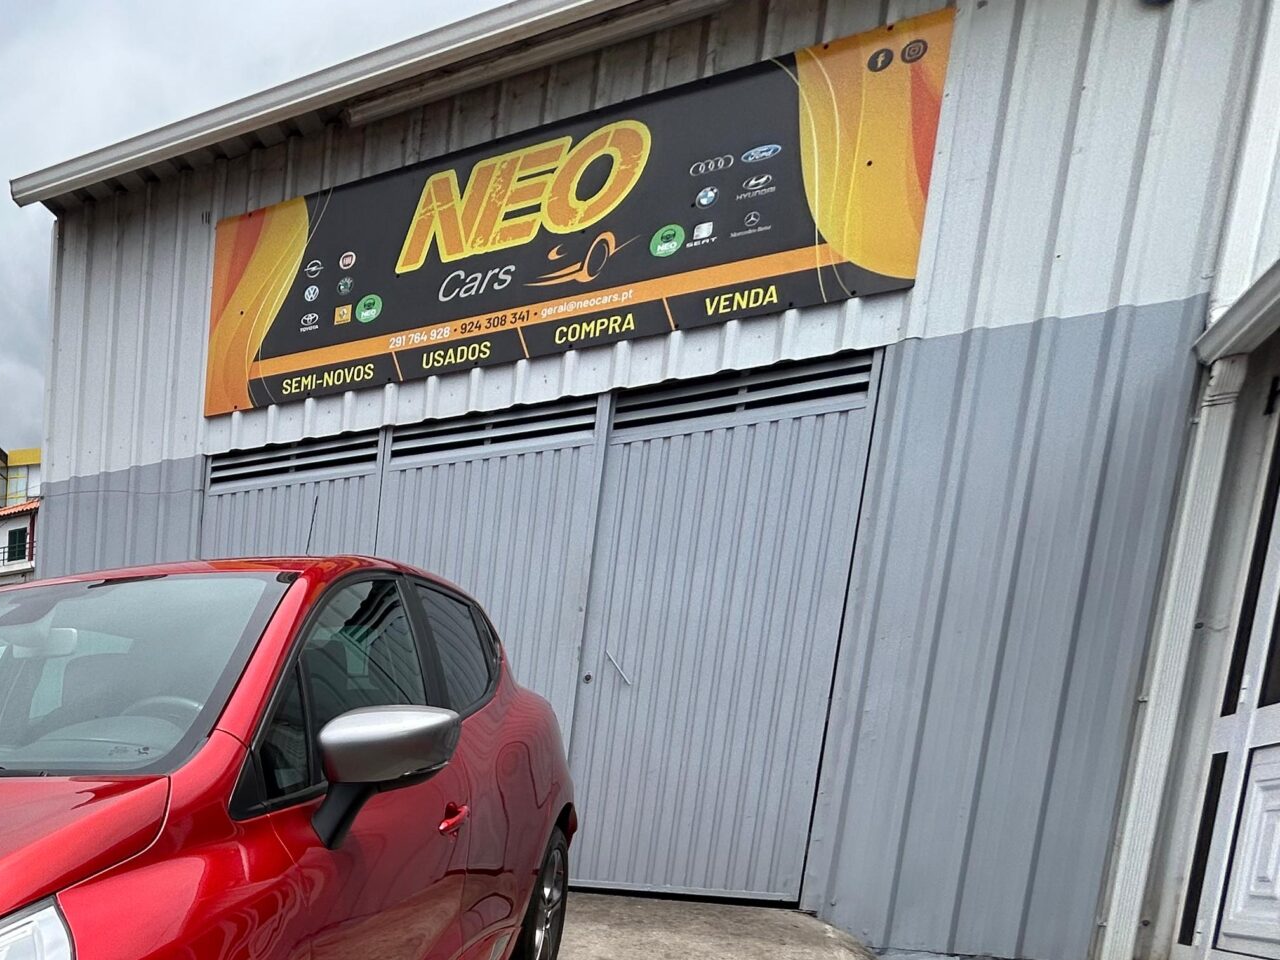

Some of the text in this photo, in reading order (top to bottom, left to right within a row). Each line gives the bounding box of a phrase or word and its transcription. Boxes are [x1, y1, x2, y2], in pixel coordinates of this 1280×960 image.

[395, 120, 651, 274] NEO
[657, 241, 677, 251] NEO
[686, 236, 718, 248] SEAT
[438, 264, 516, 302] Cars
[361, 309, 377, 319] NEO
[705, 285, 779, 316] VENDA
[300, 325, 319, 333] TOYOTA
[389, 288, 634, 349] 291 764 928 924 308 341 geral@neocars.pt
[554, 313, 636, 344] COMPRA
[422, 341, 491, 369] USADOS
[282, 363, 375, 395] SEMI-NOVOS
